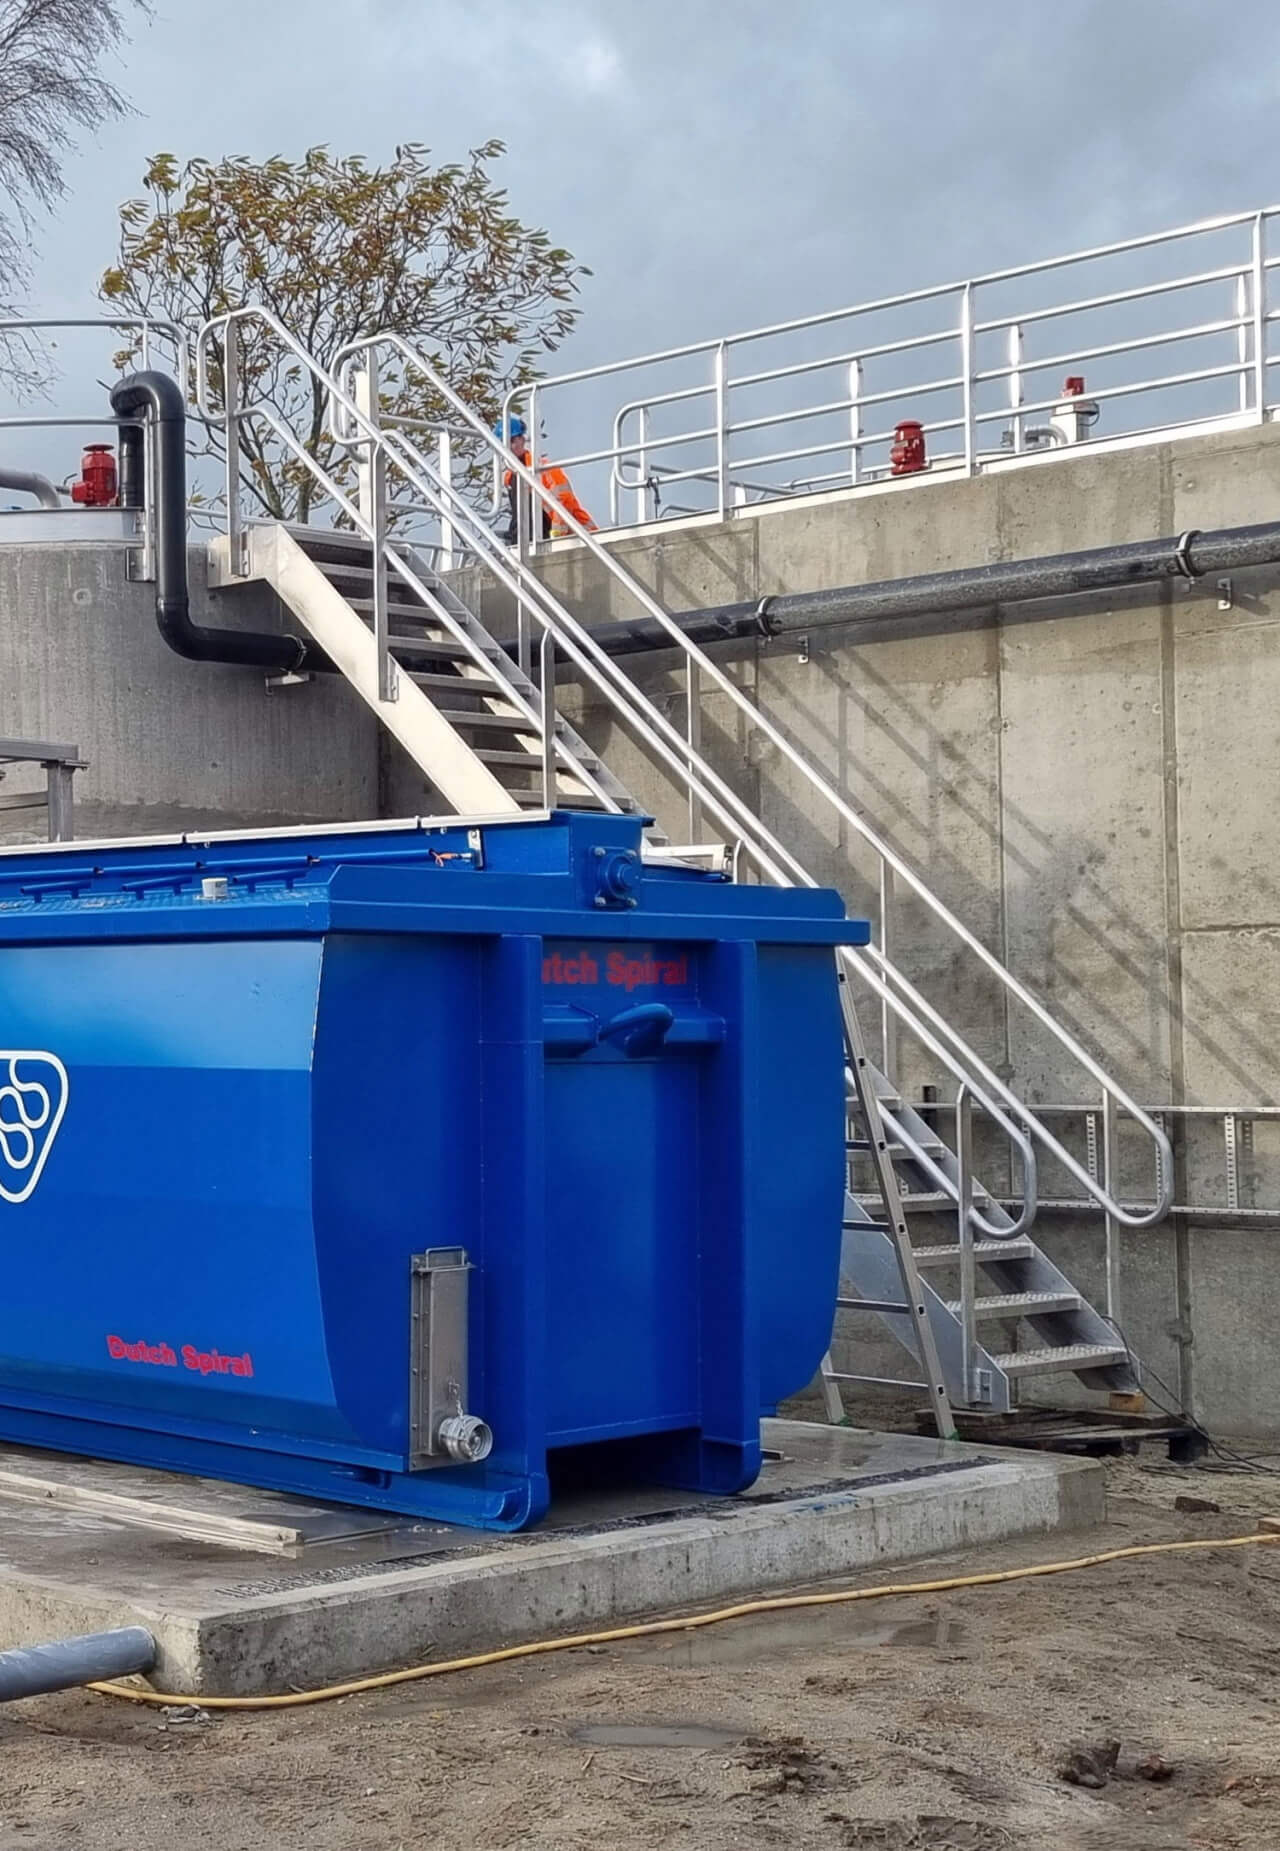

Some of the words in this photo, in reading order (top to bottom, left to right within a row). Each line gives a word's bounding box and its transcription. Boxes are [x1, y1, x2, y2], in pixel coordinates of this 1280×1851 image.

[542, 951, 598, 984] tch
[607, 951, 688, 991] Spiral
[107, 1335, 177, 1366] Dutch
[181, 1344, 253, 1376] Spiral
